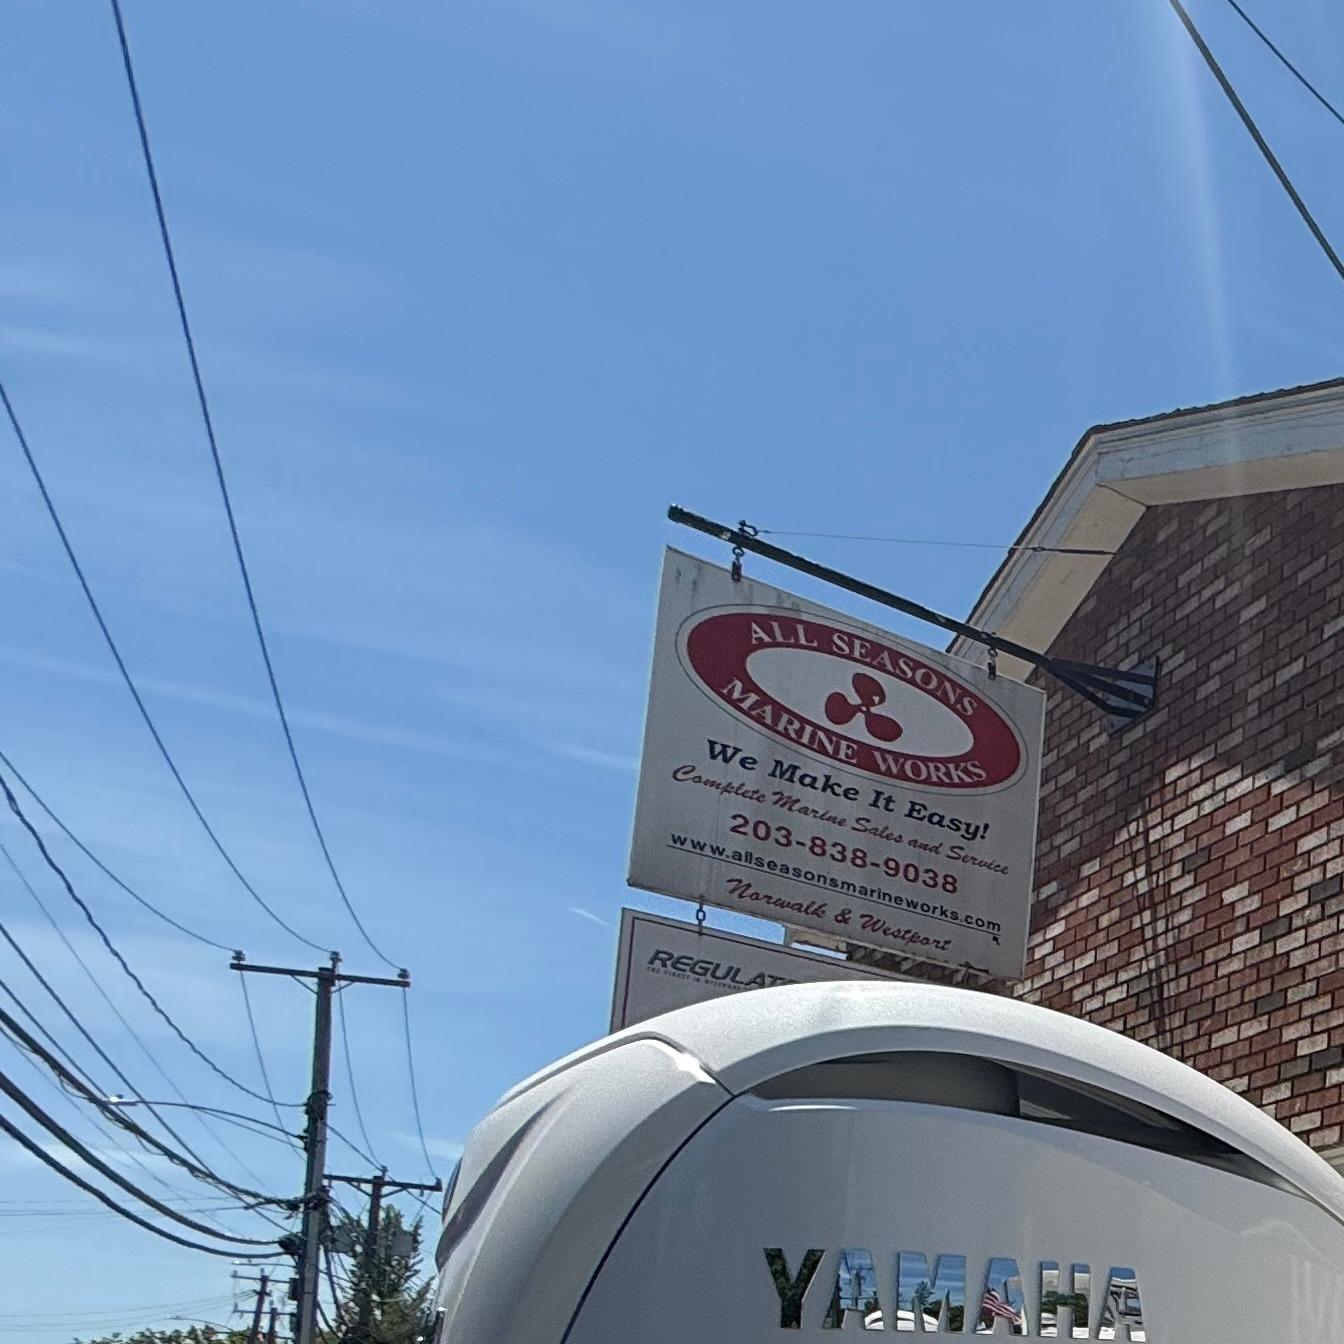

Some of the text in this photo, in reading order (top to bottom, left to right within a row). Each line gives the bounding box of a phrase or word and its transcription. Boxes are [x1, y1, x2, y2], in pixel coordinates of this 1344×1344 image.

[752, 621, 979, 717] ALL SEASONS
[720, 677, 987, 784] MARINE WORKS
[673, 765, 1010, 875] Complete Marine Sales and Service
[707, 738, 990, 841] We Make It Easy!
[671, 833, 1001, 932] www.allseasonsmarineworks.com
[729, 813, 958, 895] 203-838-9038
[726, 878, 952, 950] Norwalk & Westport
[648, 950, 797, 987] REGULAT
[762, 1247, 1148, 1343] YAMAHA
